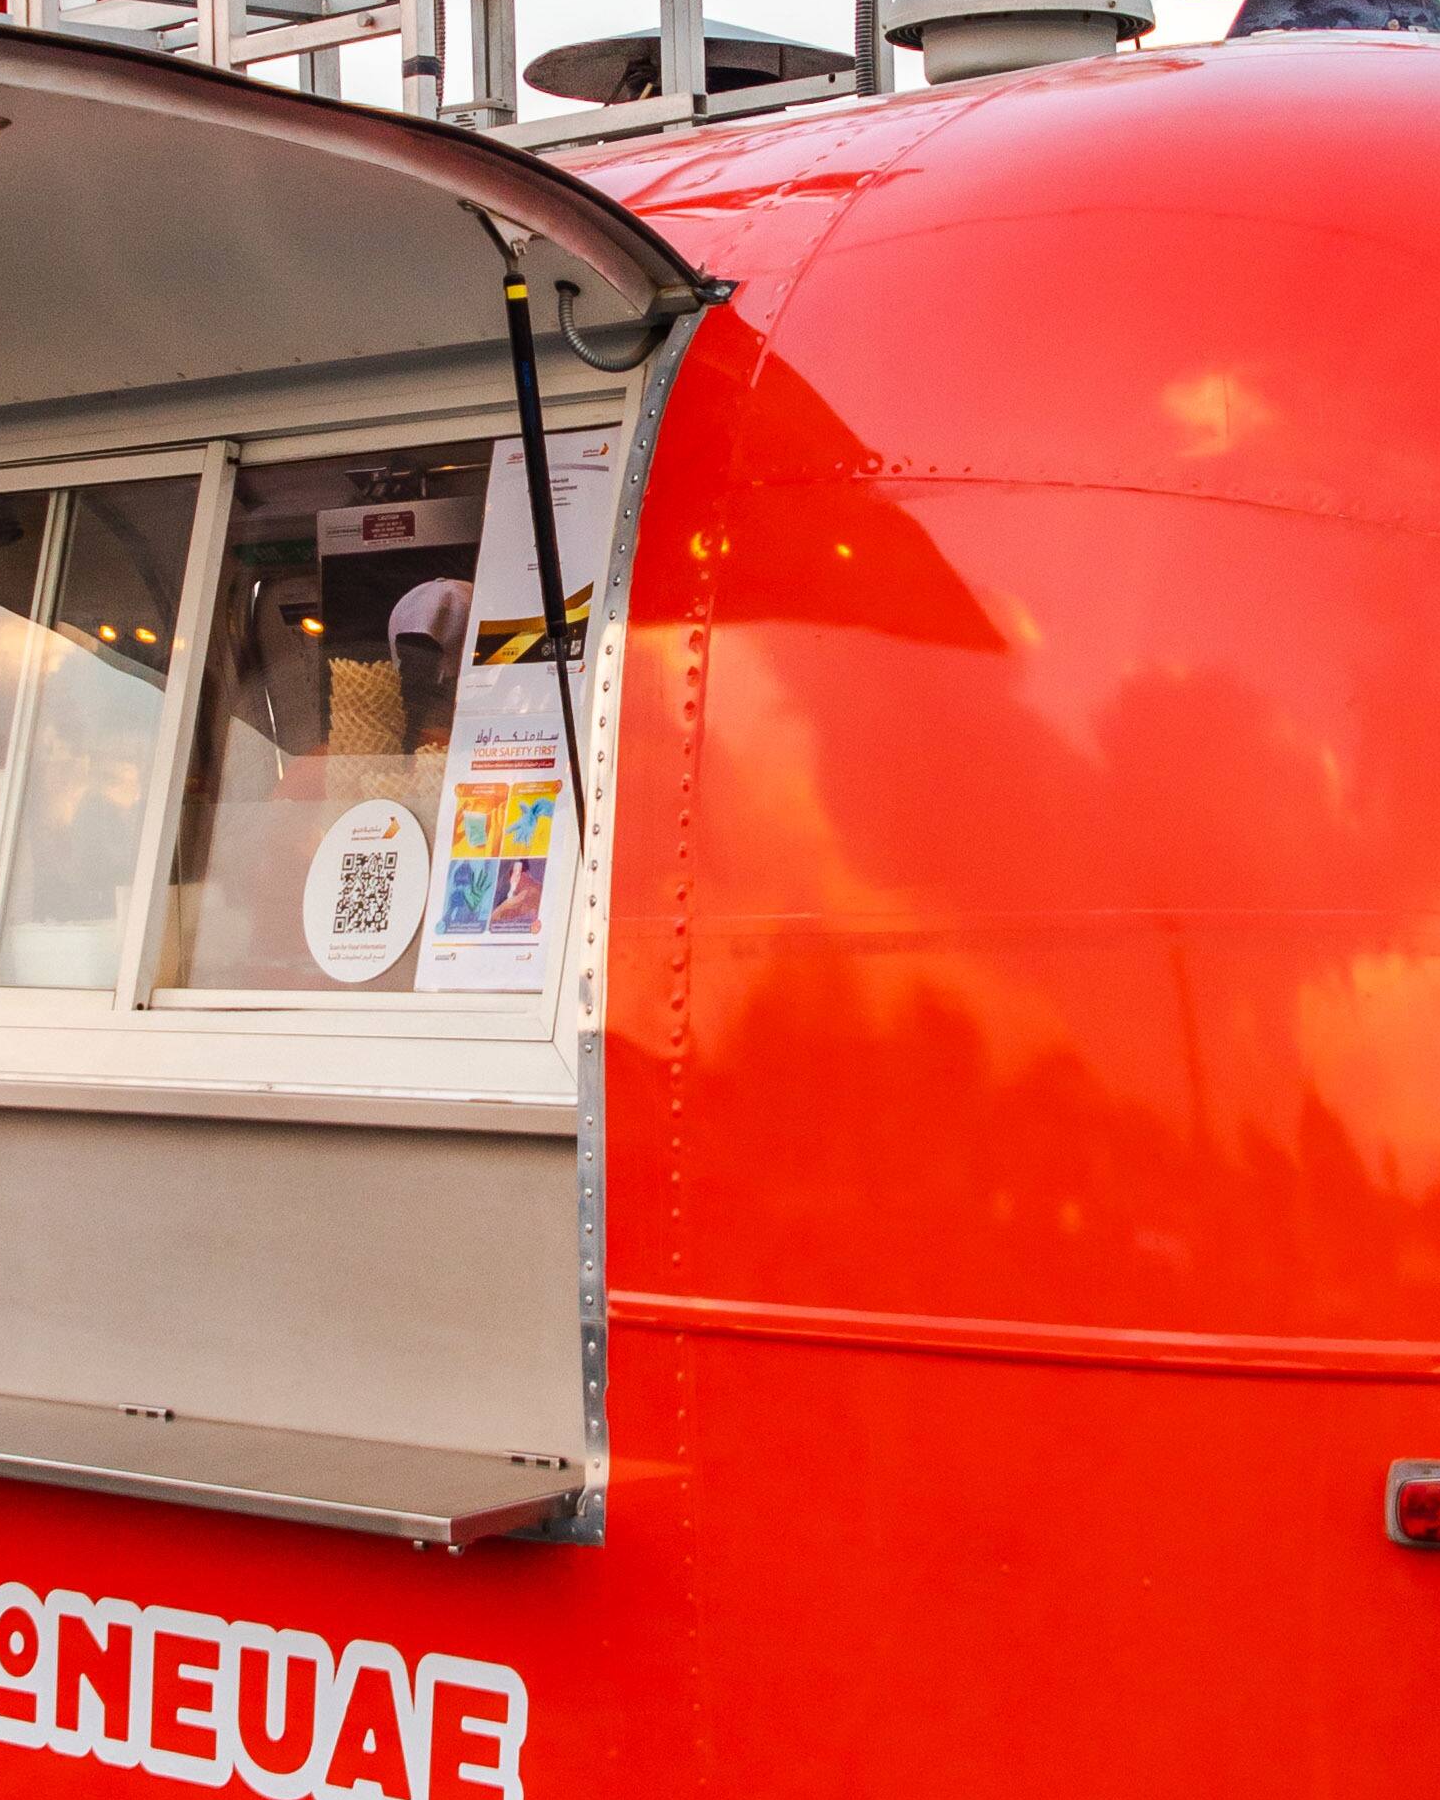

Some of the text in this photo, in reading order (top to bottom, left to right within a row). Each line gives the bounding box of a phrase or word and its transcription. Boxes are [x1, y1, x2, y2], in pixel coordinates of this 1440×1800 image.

[473, 745, 557, 757] YOUR SAFETY FIRST
